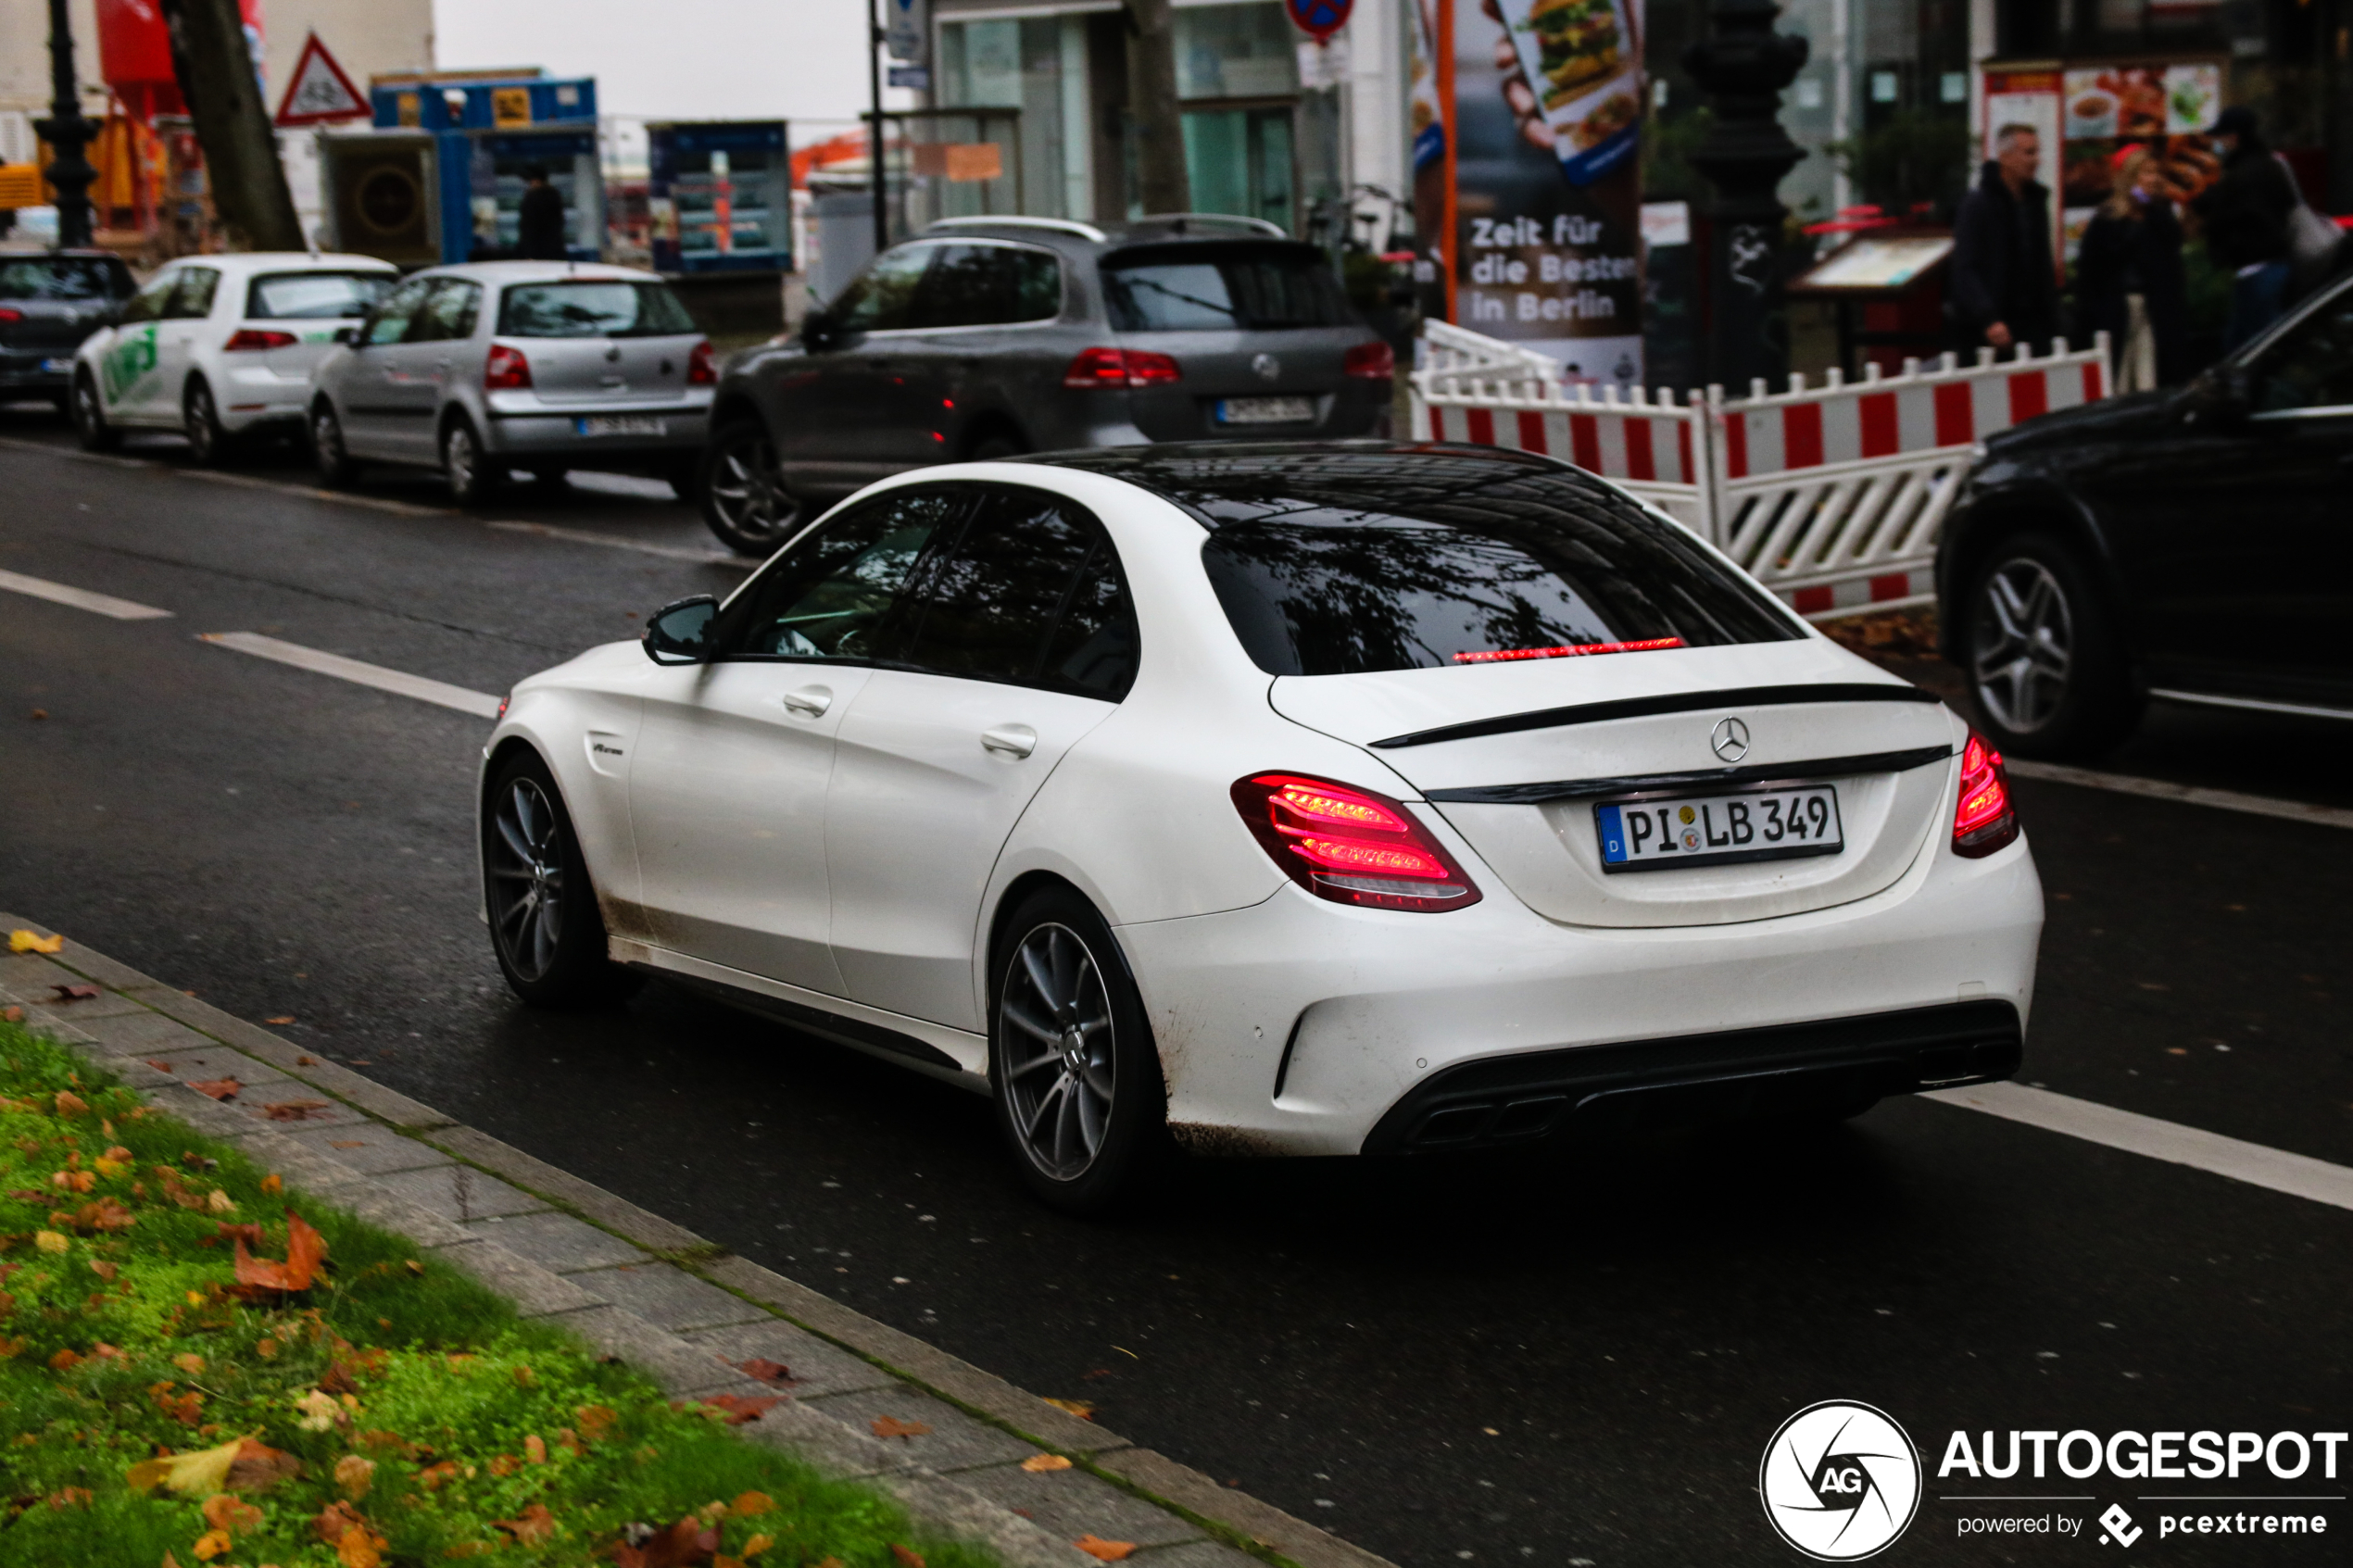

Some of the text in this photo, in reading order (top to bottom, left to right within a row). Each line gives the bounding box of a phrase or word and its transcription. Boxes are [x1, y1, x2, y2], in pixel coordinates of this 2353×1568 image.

[1471, 215, 1543, 247] Zeit
[1554, 214, 1603, 245] für
[1471, 253, 1529, 284] die
[1471, 290, 1615, 322] in Berlin
[1627, 796, 1828, 854] PI LB 349
[1609, 840, 1618, 853] D
